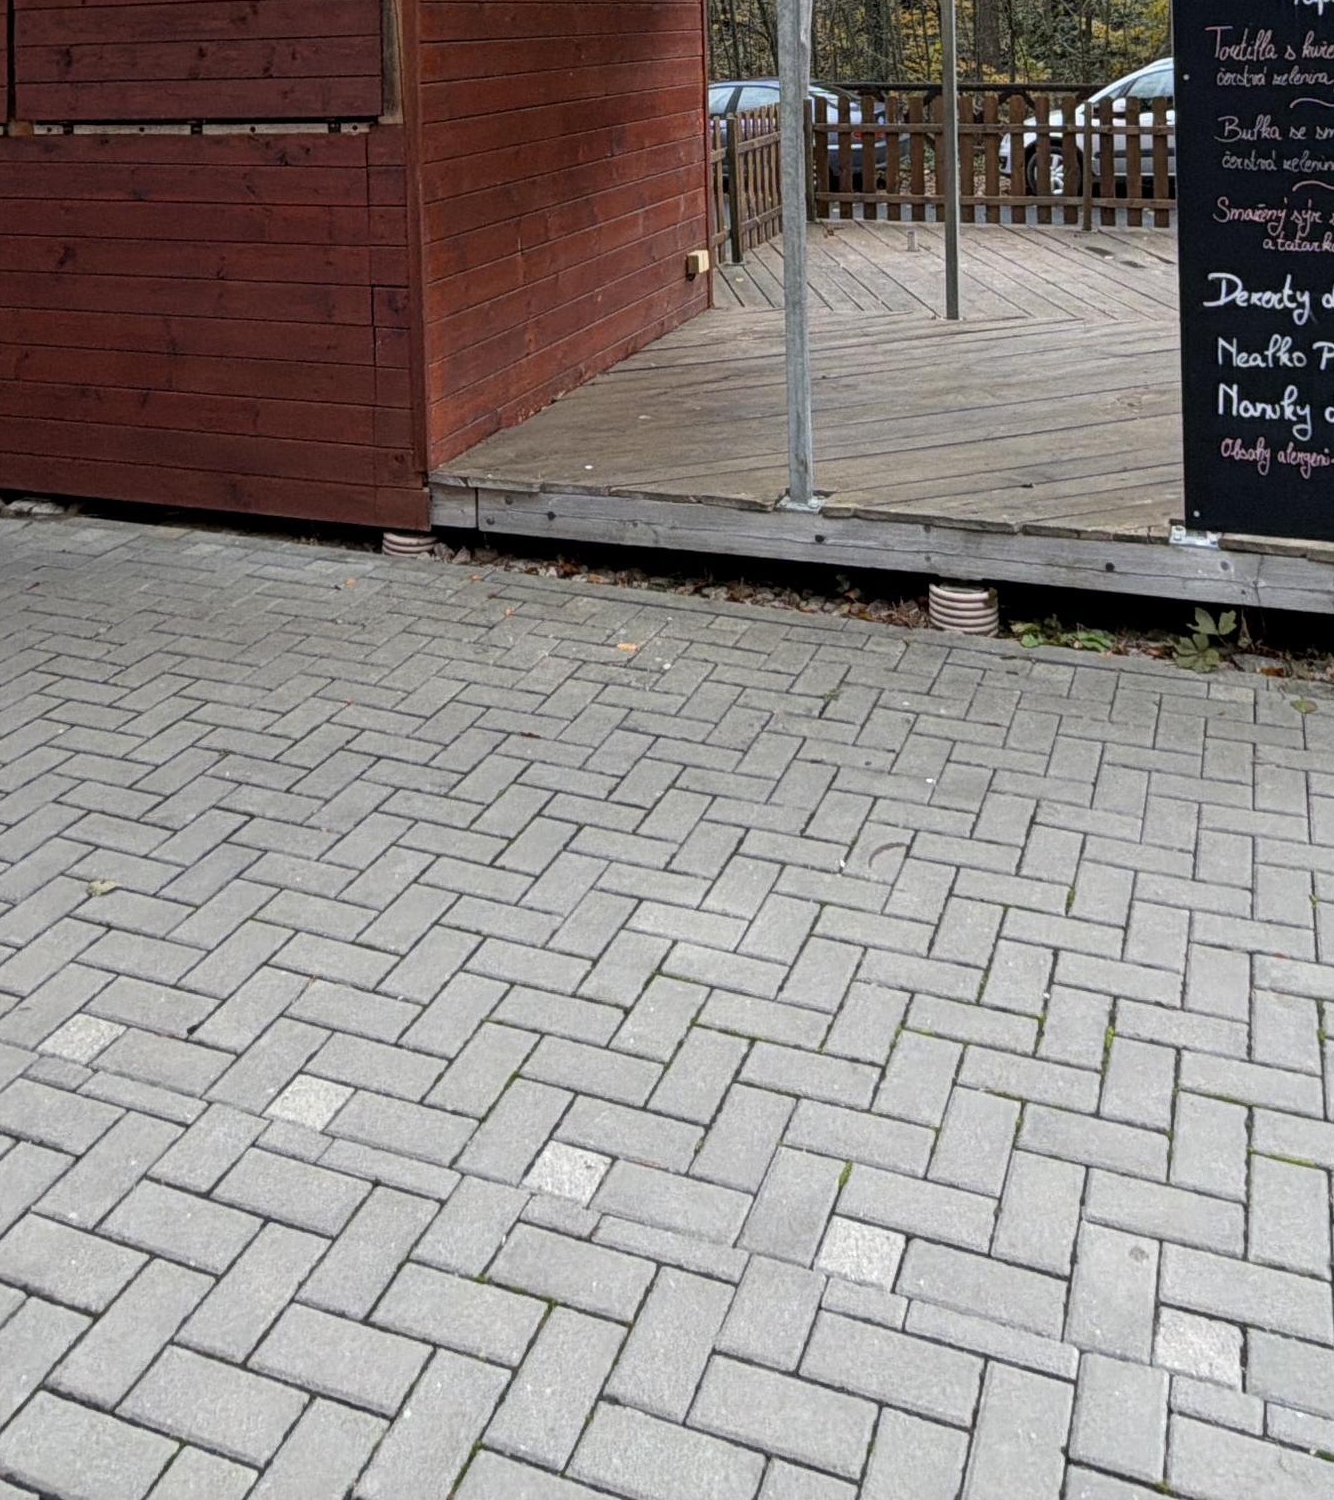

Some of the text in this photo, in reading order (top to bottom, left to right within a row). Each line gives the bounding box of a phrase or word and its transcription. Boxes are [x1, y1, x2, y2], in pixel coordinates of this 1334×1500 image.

[1205, 25, 1278, 62] Tortilla
[1283, 45, 1297, 60] s
[1214, 114, 1282, 142] Bulka
[1289, 125, 1307, 140] se
[1290, 199, 1323, 236] sýr
[1262, 237, 1274, 250] a
[1202, 272, 1310, 326] Dezerty
[1217, 334, 1308, 368] Nealko
[1217, 383, 1313, 441] Nanuky
